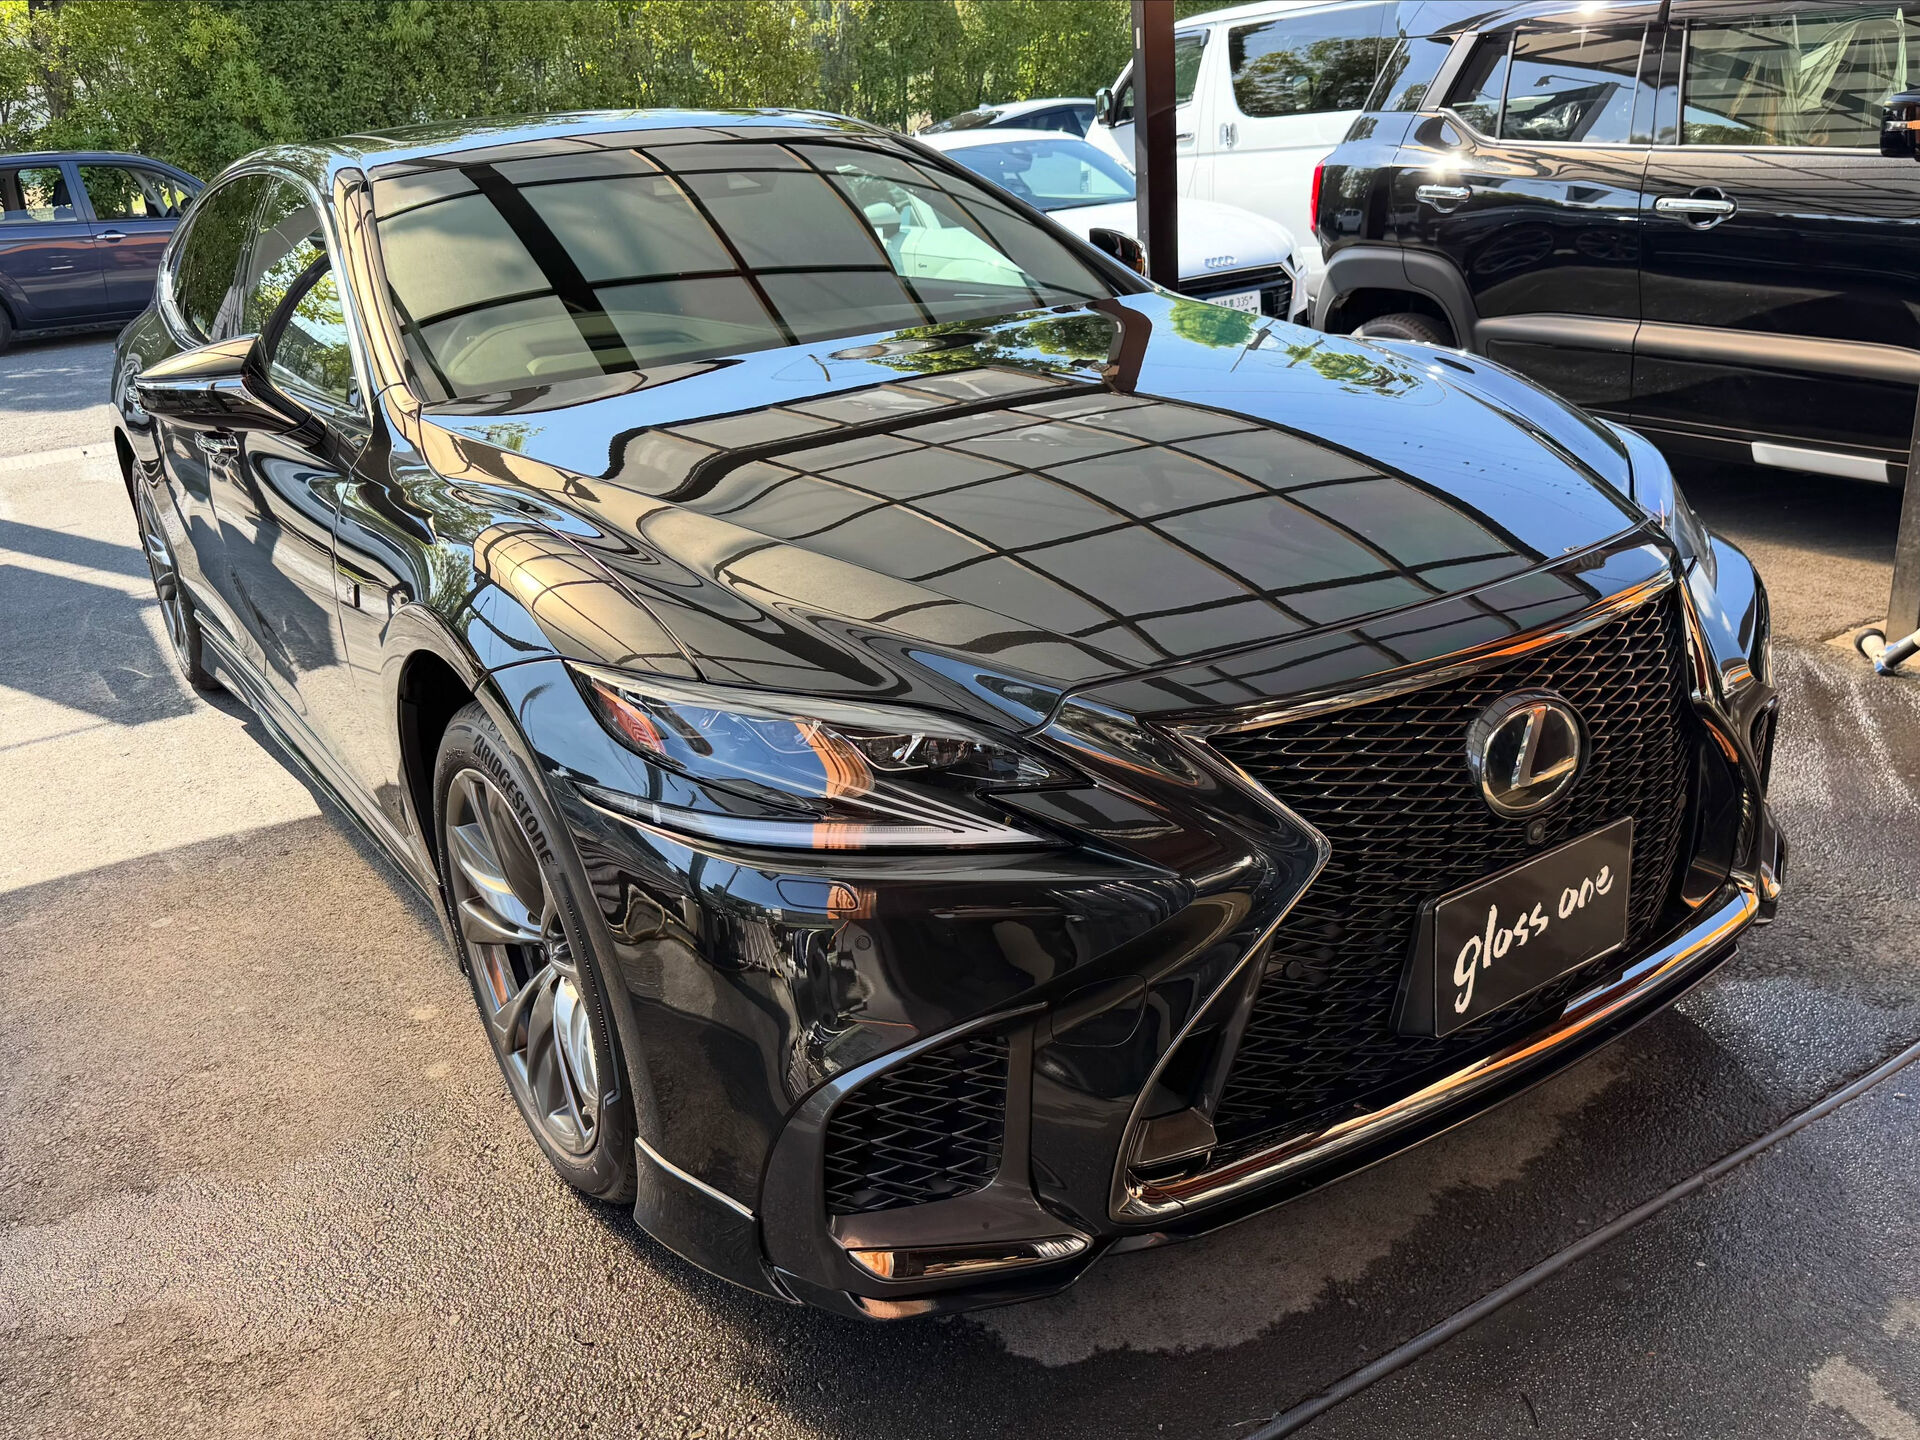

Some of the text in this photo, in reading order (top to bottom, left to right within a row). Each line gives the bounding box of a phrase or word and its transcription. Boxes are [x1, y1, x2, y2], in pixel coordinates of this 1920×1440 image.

[472, 735, 555, 867] BRIDGESTONE
[1453, 865, 1614, 1014] gloss one
